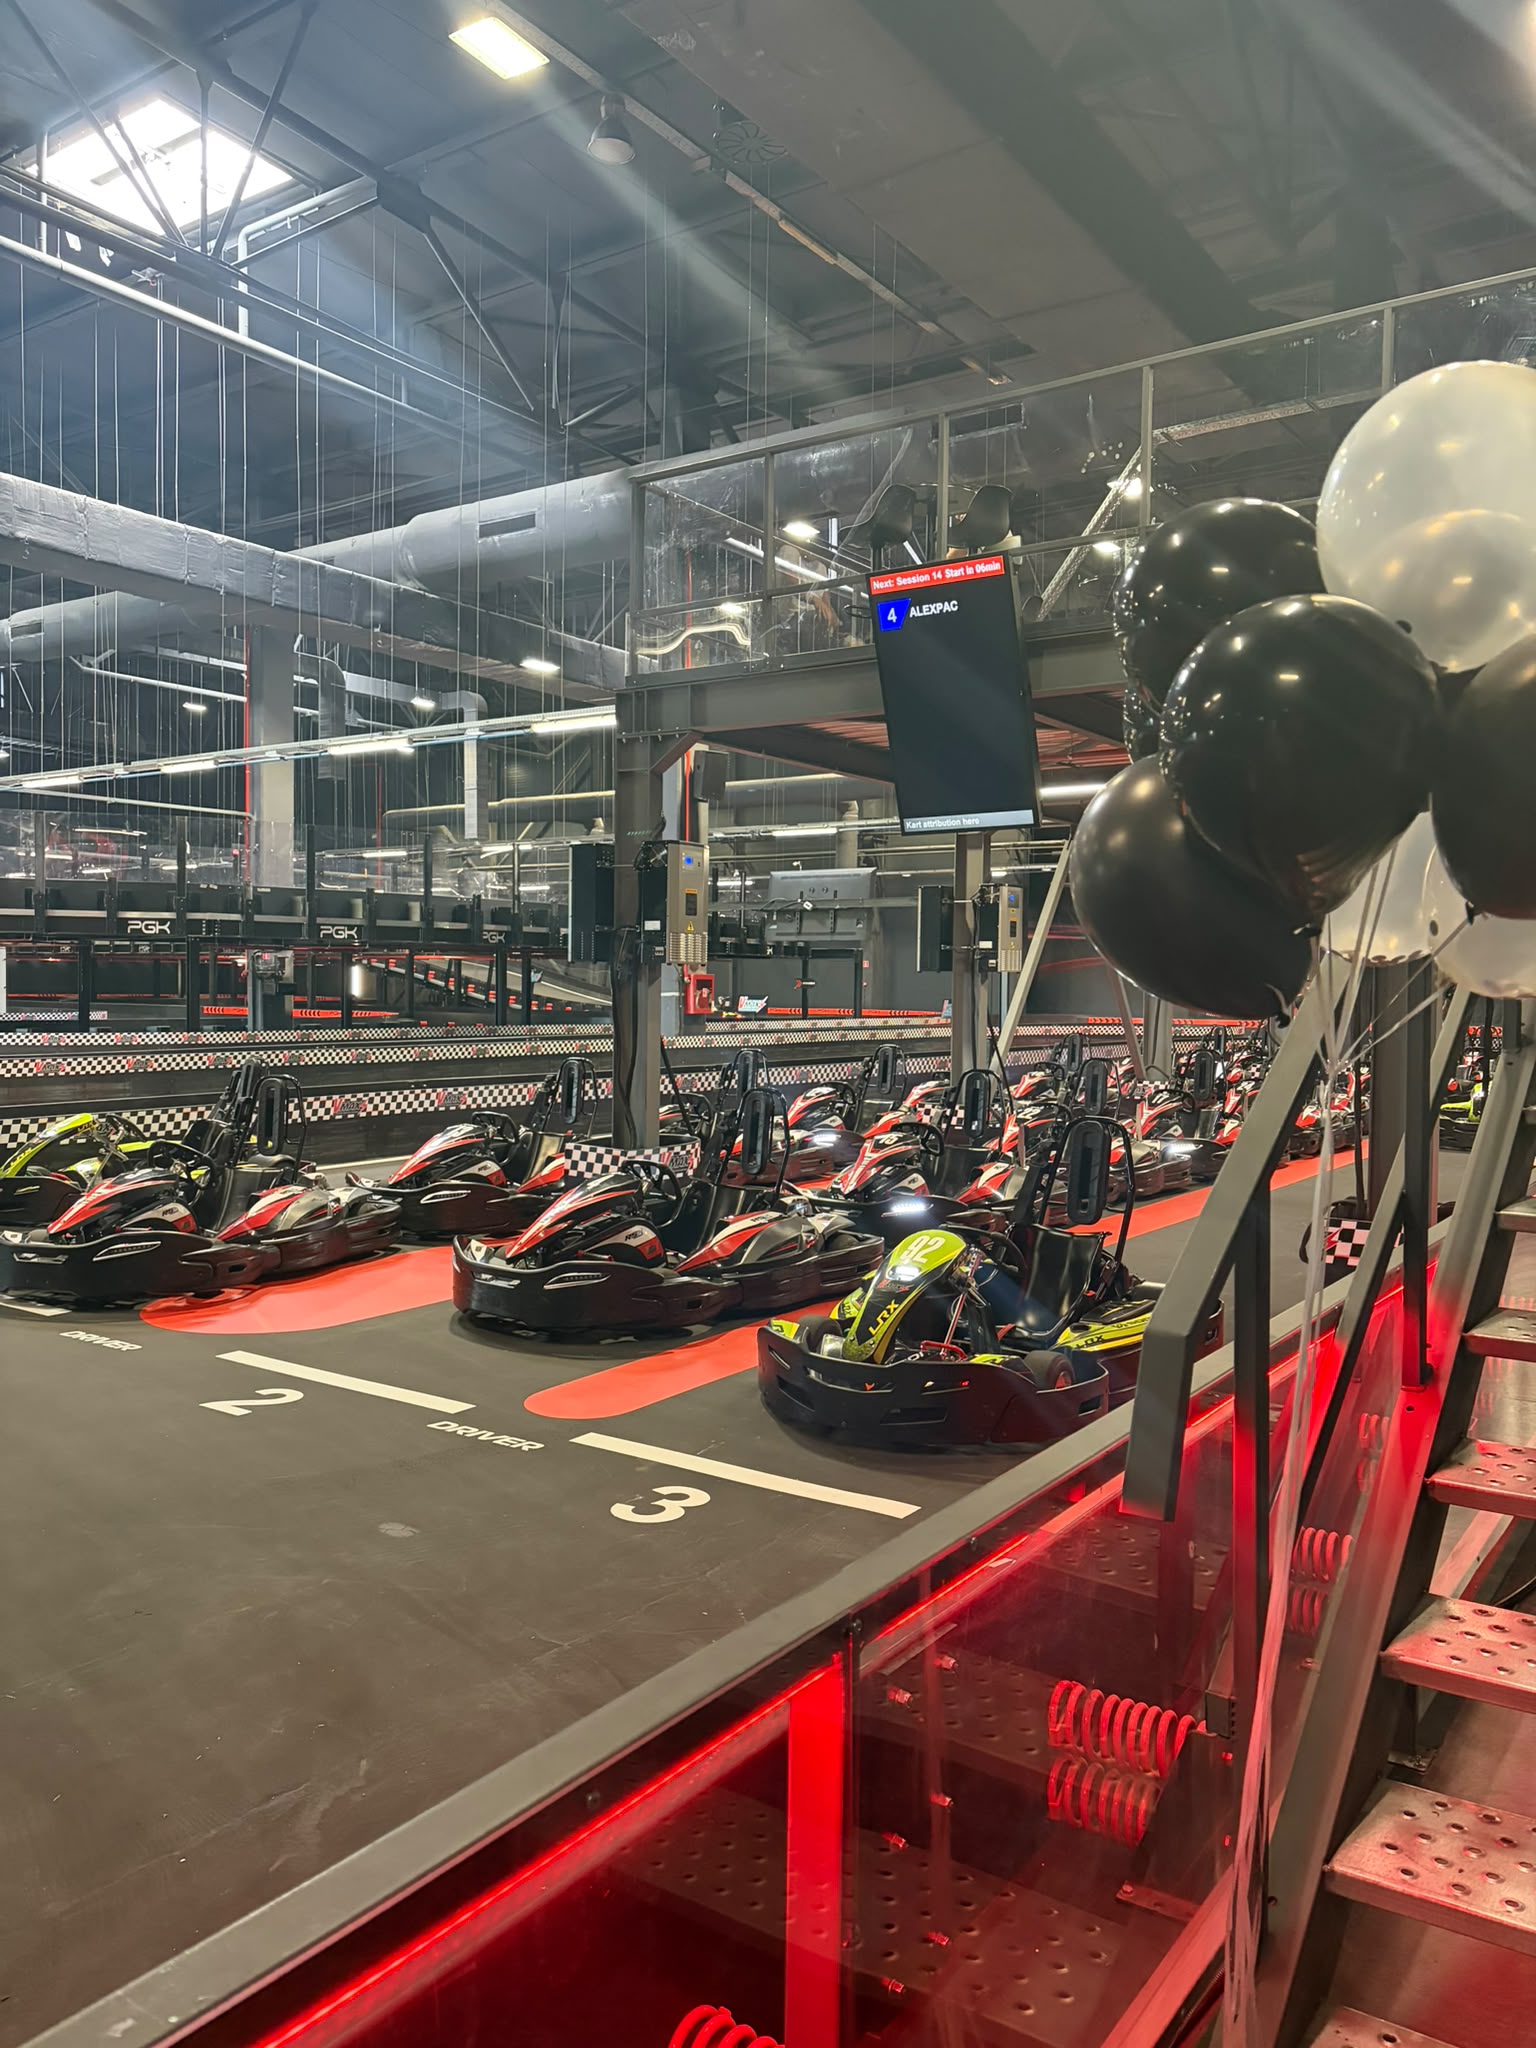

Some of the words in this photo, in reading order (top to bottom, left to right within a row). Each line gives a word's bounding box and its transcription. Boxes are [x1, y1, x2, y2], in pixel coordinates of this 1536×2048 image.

[873, 579, 895, 590] Next:
[896, 573, 930, 586] Session
[932, 570, 942, 580] 14
[944, 567, 965, 579] Start
[966, 565, 974, 576] in
[975, 560, 1001, 575] 06min
[887, 607, 898, 623] 4
[909, 600, 959, 618] ALEXPAC
[905, 821, 922, 829] Kart
[923, 818, 961, 828] attribution
[962, 817, 980, 826] here
[127, 920, 171, 935] PGK
[319, 925, 358, 939] PGK
[900, 1235, 946, 1265] 92
[868, 1299, 900, 1336] LRX
[59, 1330, 143, 1351] DRIVER
[199, 1388, 304, 1416] 2
[426, 1420, 545, 1451] DRIVER
[610, 1485, 711, 1524] 3
